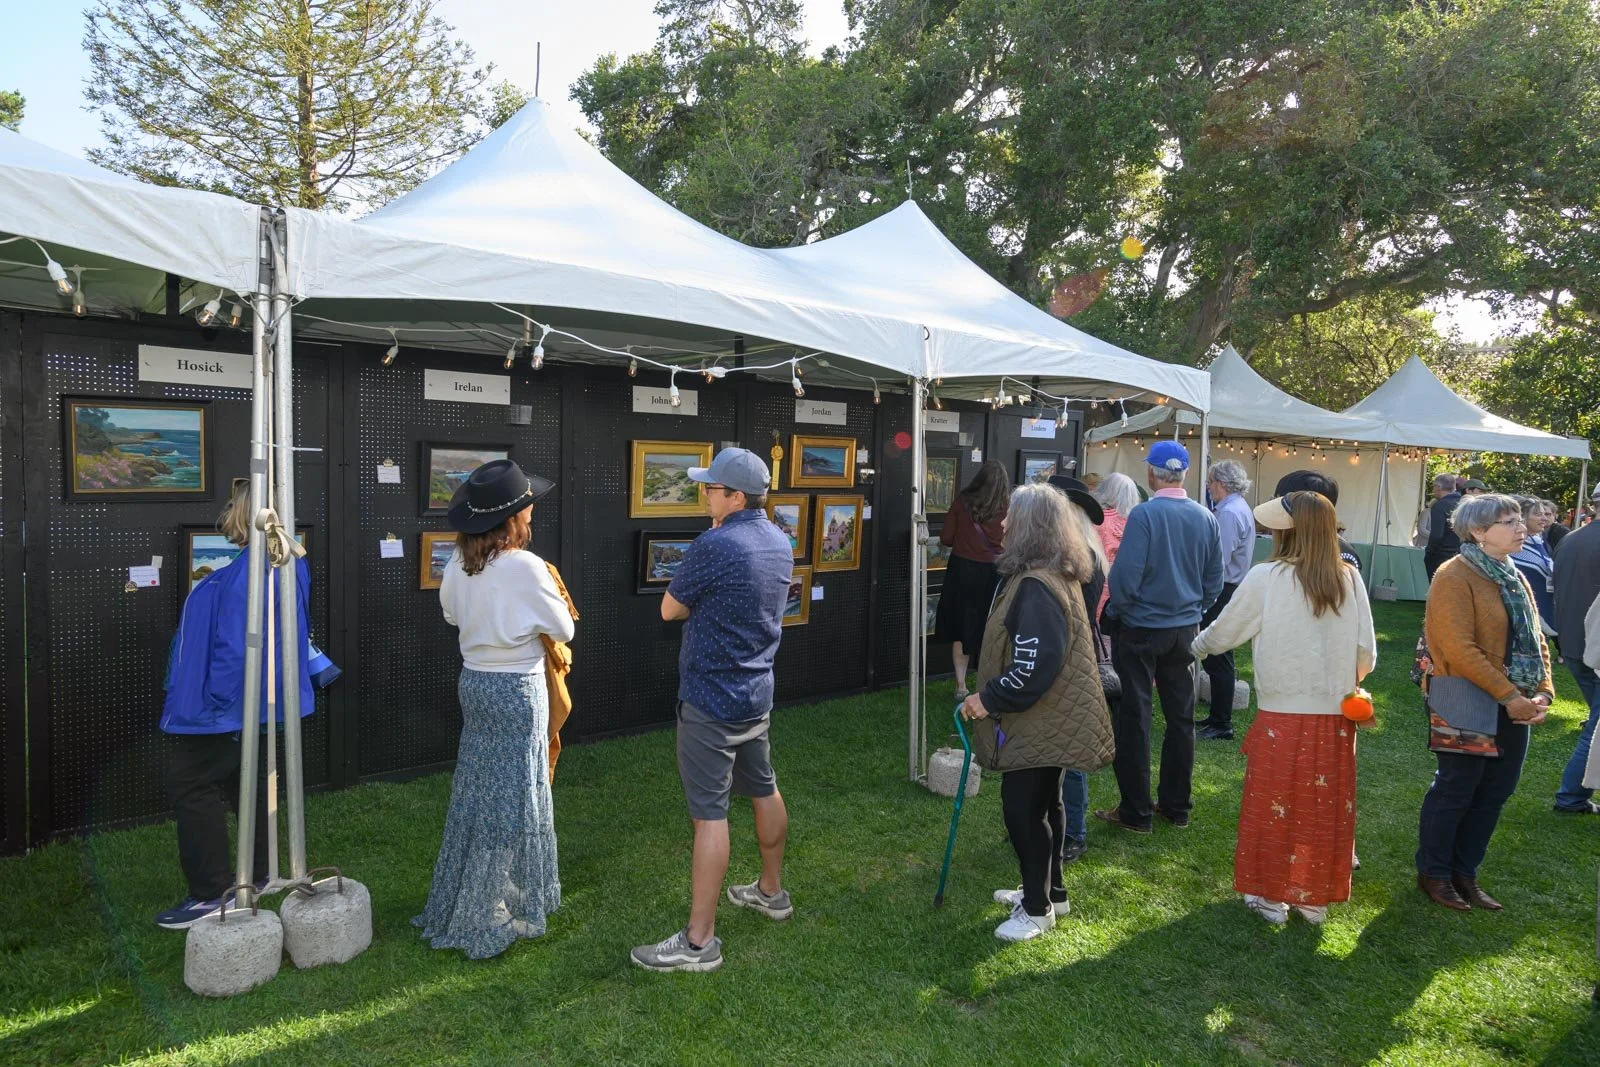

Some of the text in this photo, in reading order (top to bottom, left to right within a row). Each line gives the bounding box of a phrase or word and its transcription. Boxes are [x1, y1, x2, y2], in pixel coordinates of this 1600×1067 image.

[177, 359, 224, 373] Hosick
[454, 381, 483, 393] Irelan
[651, 395, 674, 405] Johns
[811, 407, 832, 416] Jordan
